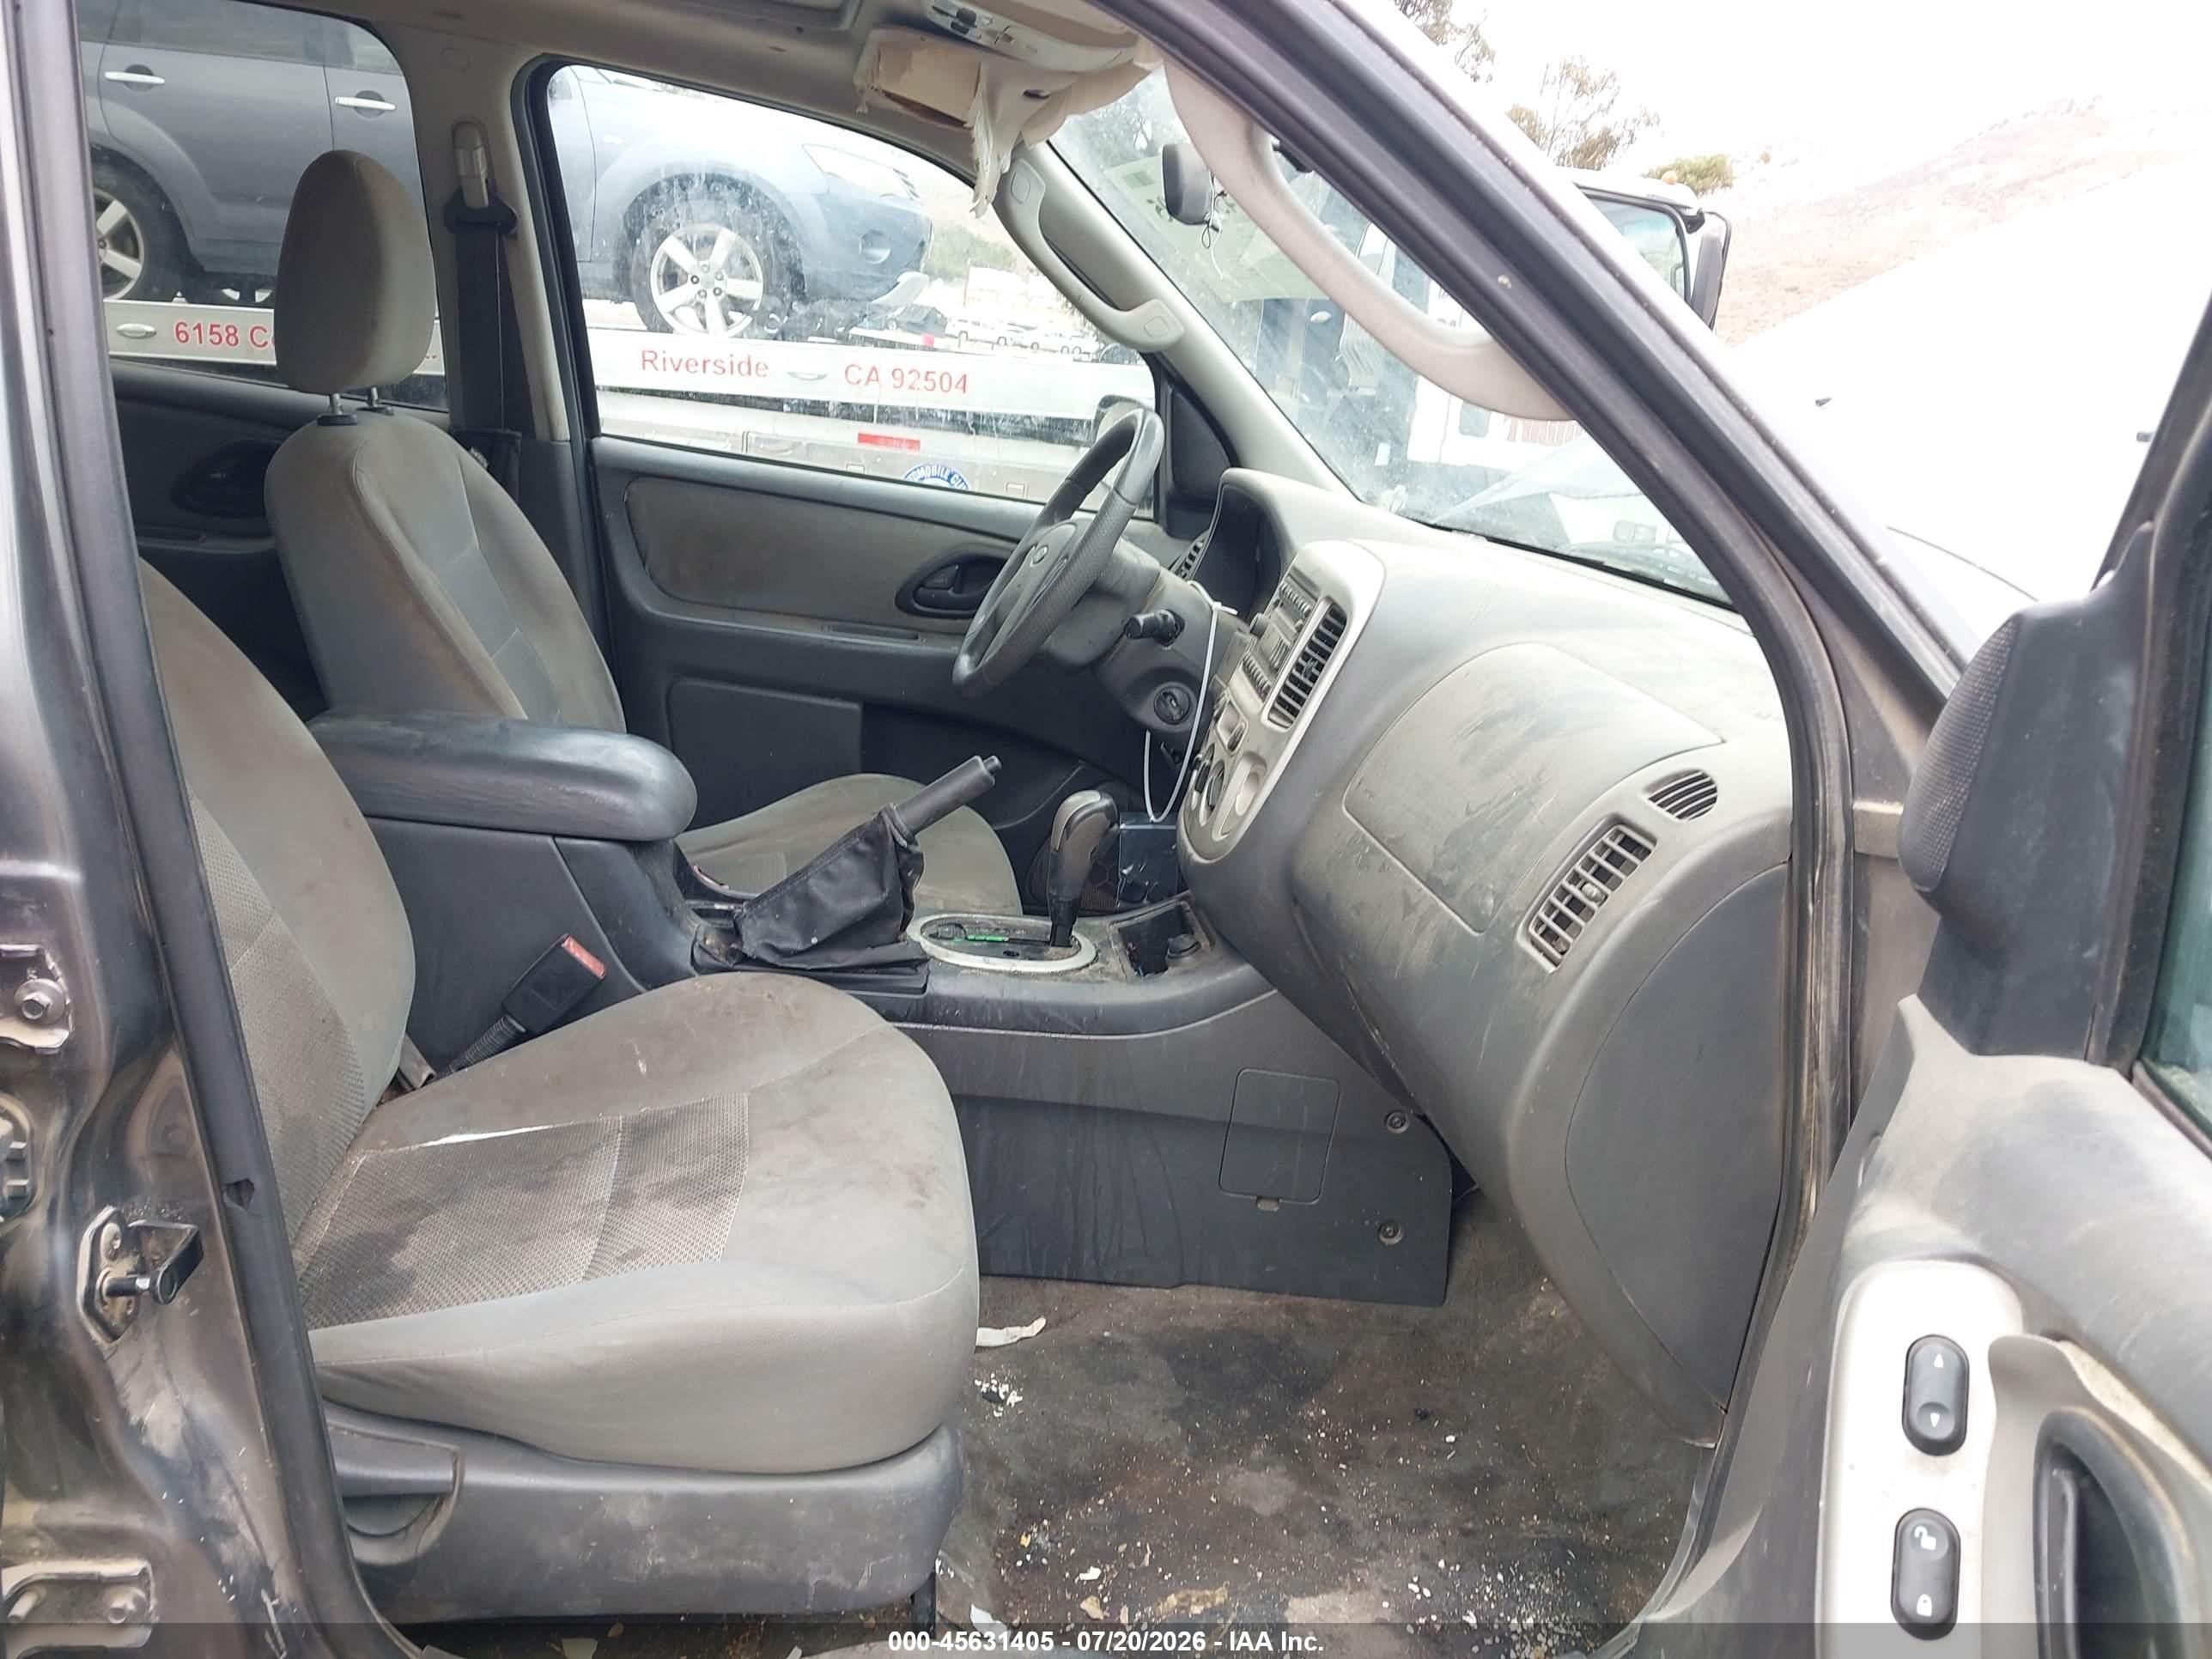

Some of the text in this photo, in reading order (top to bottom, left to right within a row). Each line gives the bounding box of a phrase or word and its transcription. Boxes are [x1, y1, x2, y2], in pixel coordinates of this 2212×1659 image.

[174, 321, 240, 347] 6158
[641, 349, 968, 394] Riverside CA 92504
